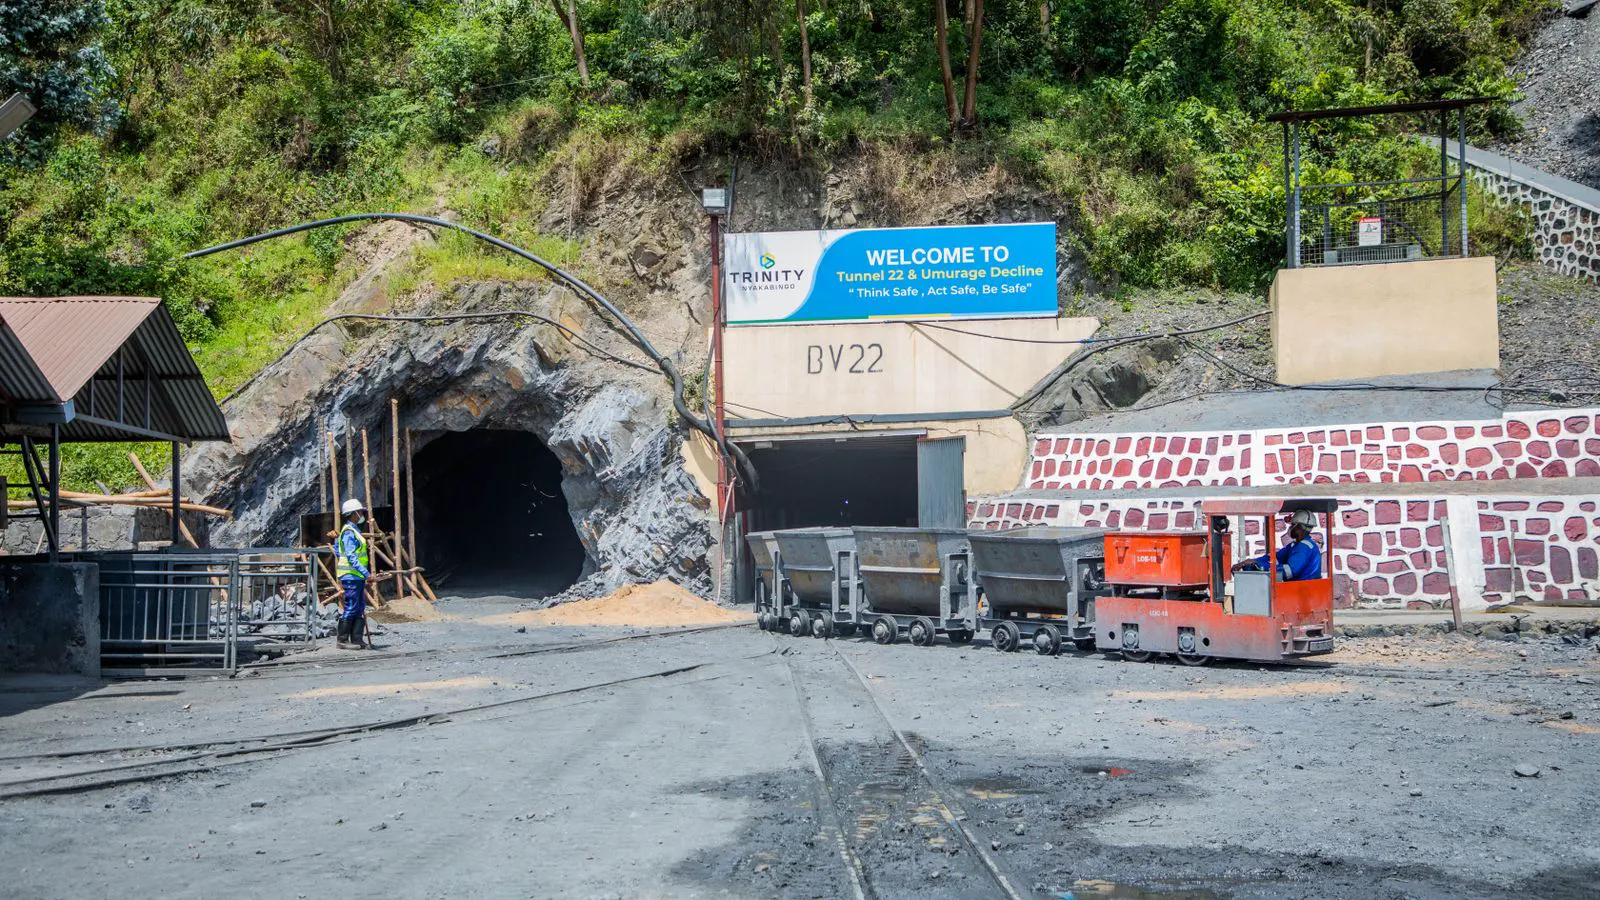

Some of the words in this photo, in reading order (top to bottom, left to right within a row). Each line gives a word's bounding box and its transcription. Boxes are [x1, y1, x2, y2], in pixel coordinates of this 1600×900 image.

[866, 248, 975, 266] WELCOME
[980, 245, 1009, 263] TO
[729, 269, 805, 283] TRINITY
[836, 270, 885, 282] Tunnel
[888, 269, 904, 281] 22
[907, 269, 917, 280] &
[921, 268, 987, 281] Umurage
[990, 265, 1044, 278] Decline
[742, 283, 795, 291] NYAKABINGO
[857, 287, 890, 298] Think
[893, 286, 919, 297] Safe
[927, 286, 948, 296] Act
[950, 284, 979, 296] Safe,
[982, 284, 998, 295] Be
[807, 343, 883, 374] BV22
